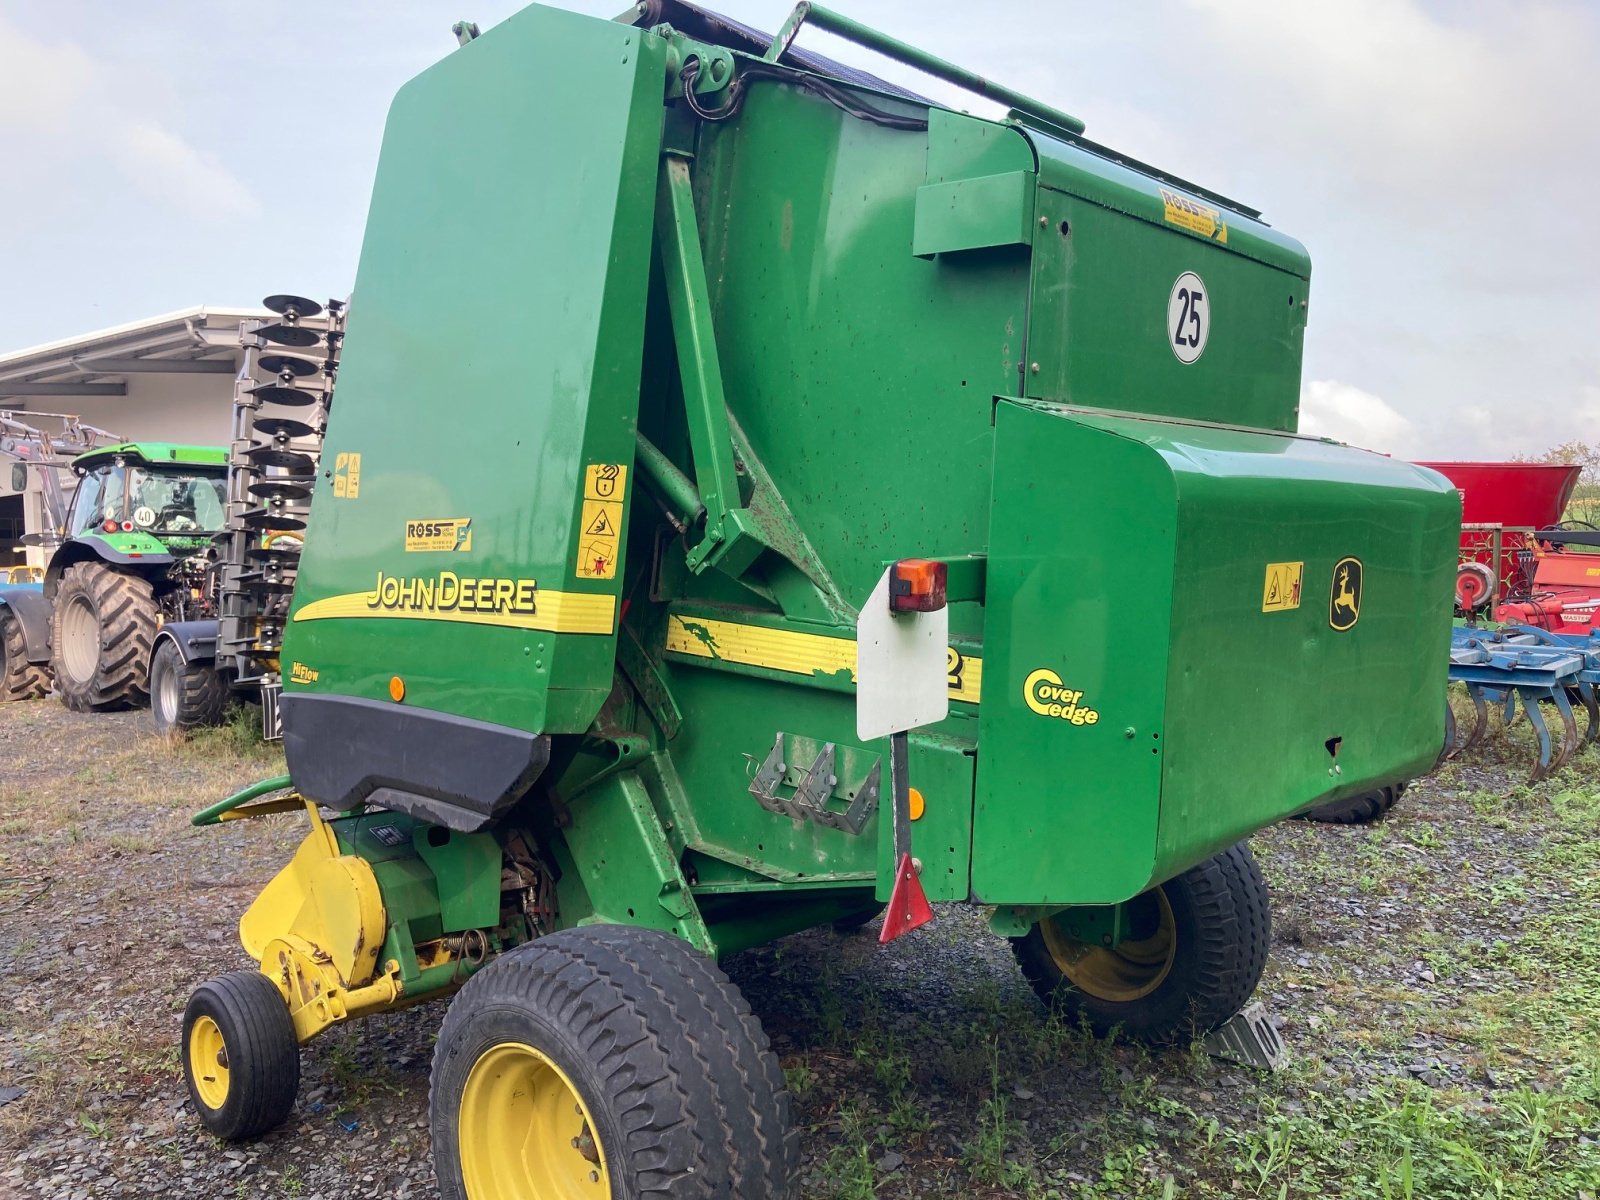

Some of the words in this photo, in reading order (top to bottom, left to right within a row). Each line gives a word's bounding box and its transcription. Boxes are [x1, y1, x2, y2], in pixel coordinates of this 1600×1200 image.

[1161, 190, 1200, 217] ROSS
[1175, 287, 1203, 349] 25
[138, 511, 151, 523] 40
[407, 522, 444, 539] ROSS
[367, 571, 436, 609] JOHN
[438, 571, 538, 615] DEERE
[292, 661, 320, 682] HiFlow
[1023, 668, 1084, 716] Cover
[1048, 703, 1100, 725] edge
